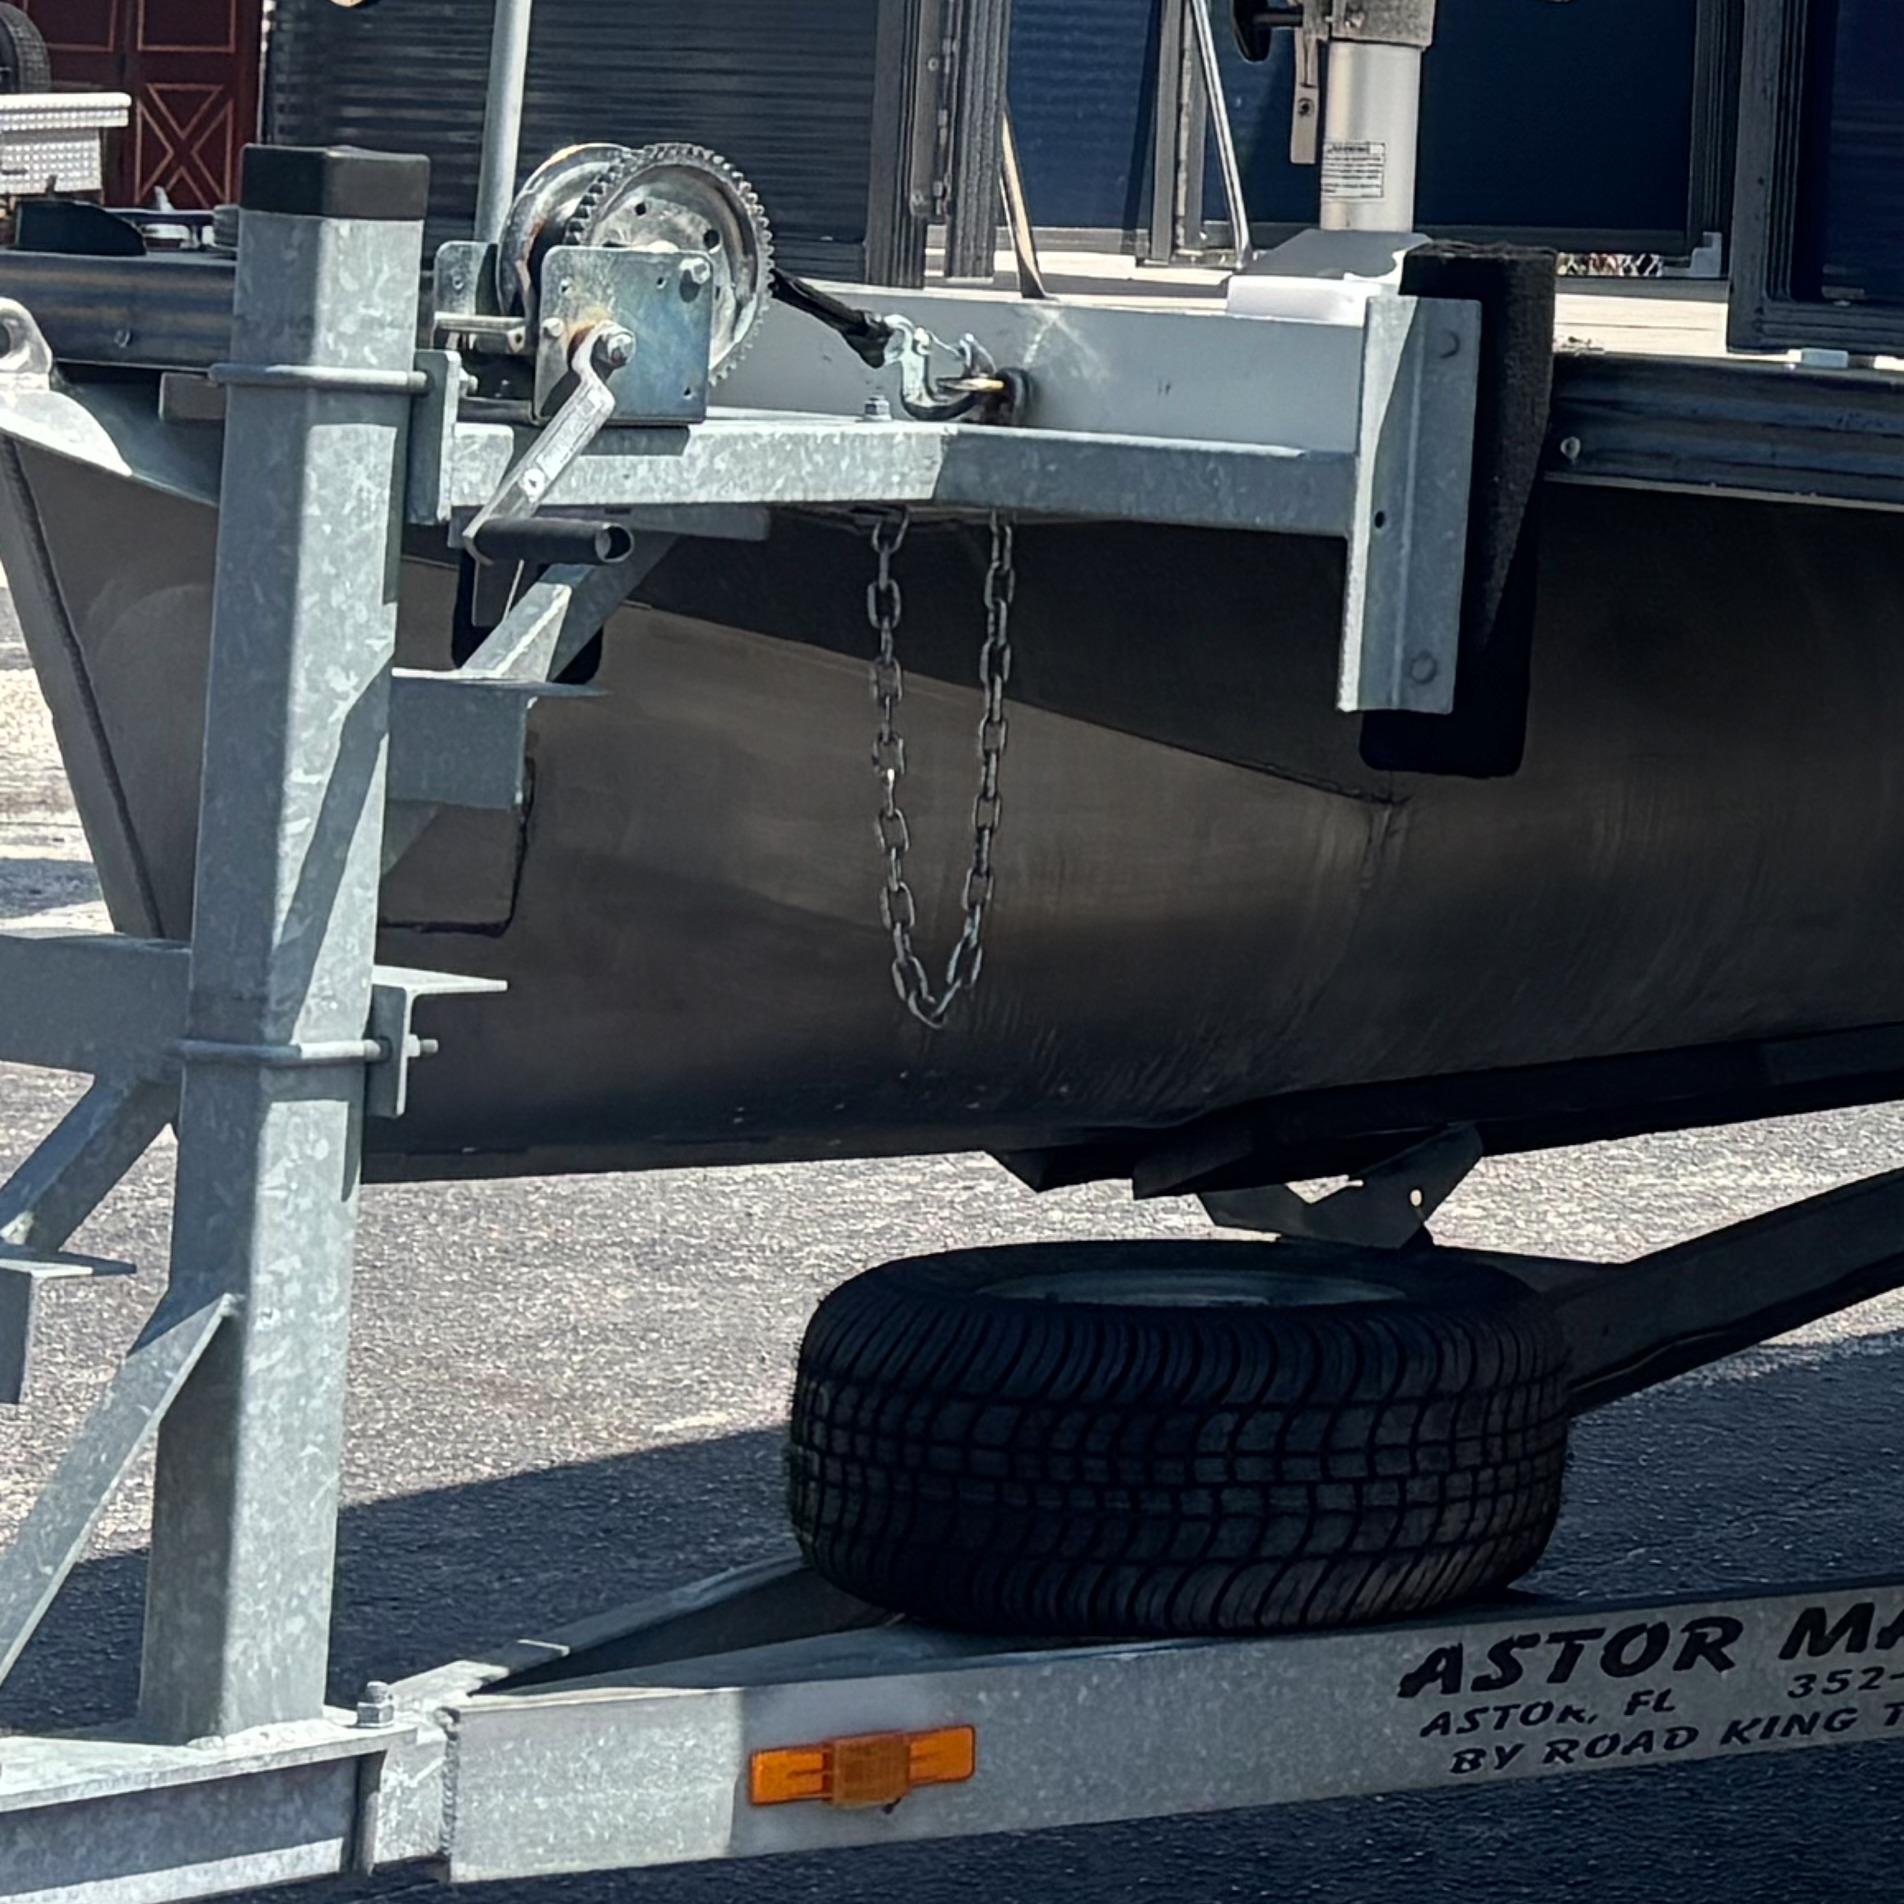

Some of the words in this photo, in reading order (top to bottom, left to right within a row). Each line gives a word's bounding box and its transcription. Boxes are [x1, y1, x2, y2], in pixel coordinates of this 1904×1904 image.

[1397, 1616, 1744, 1698] ASTOR
[1624, 1688, 1677, 1717] FL
[1450, 1742, 1526, 1774] BY
[1542, 1725, 1700, 1765] ROAD
[1719, 1707, 1859, 1746] KING
